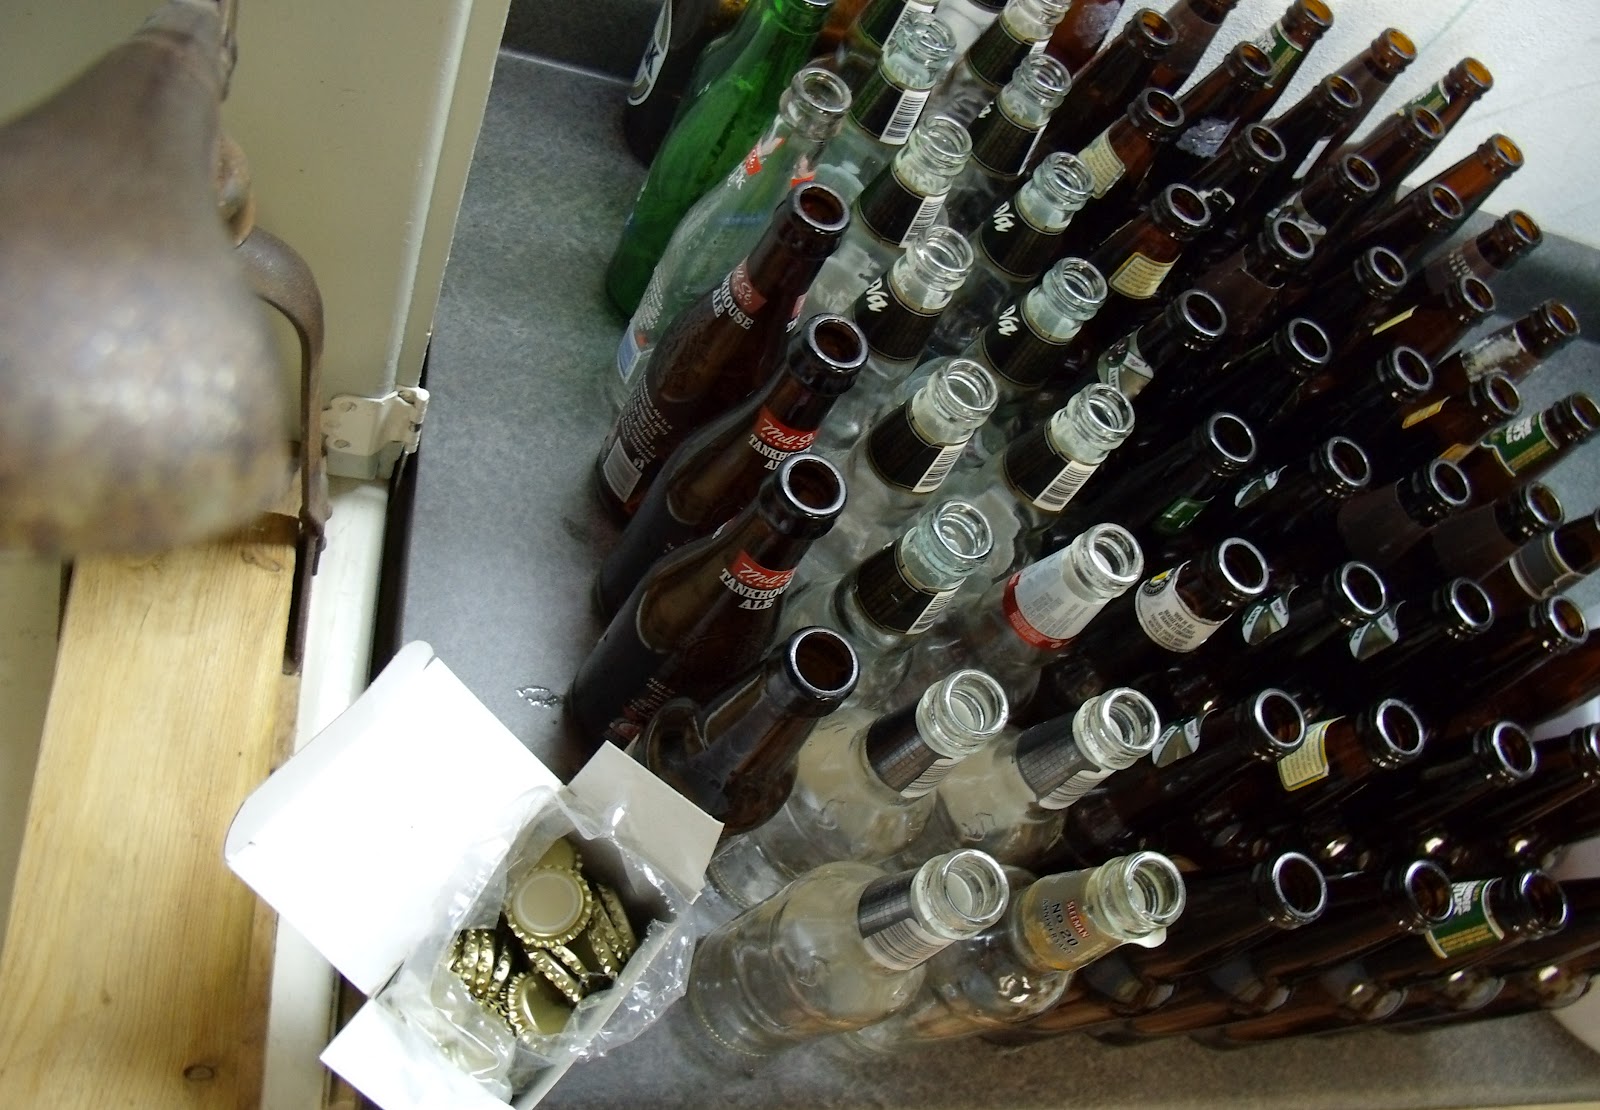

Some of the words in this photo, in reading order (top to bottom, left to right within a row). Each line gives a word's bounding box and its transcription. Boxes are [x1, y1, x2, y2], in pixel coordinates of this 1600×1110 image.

[712, 290, 725, 318] ALE
[761, 418, 800, 445] Mill
[739, 562, 785, 585] Mill
[738, 597, 775, 611] ALE
[1042, 898, 1074, 954] ANNIVERSARY
[1066, 899, 1090, 939] SLEEMAN
[1059, 928, 1079, 946] 20
